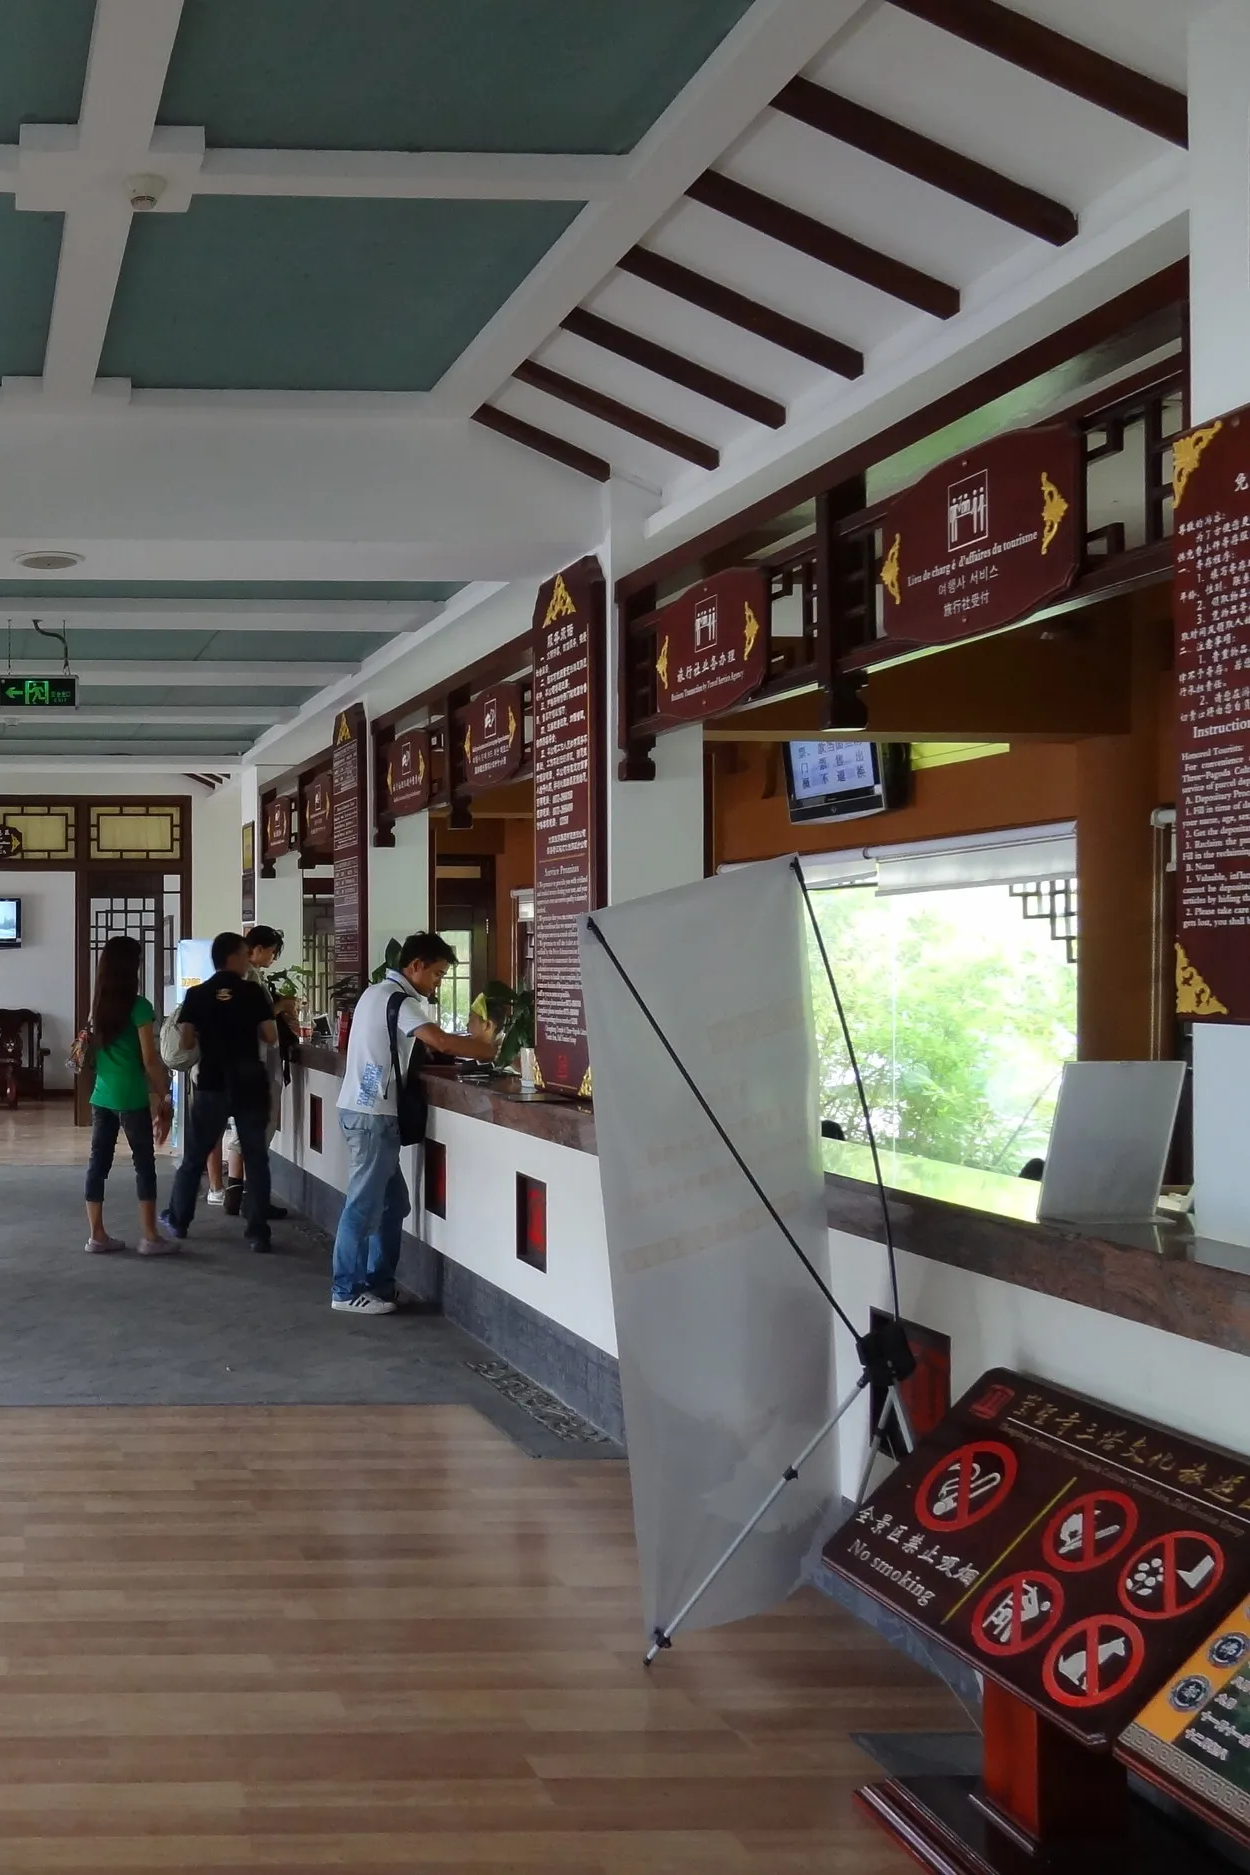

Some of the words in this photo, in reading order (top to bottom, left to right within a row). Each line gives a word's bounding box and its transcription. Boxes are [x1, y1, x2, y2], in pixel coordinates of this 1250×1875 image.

[907, 575, 922, 587] Lieu
[922, 569, 931, 581] de
[992, 542, 1002, 555] du
[1003, 531, 1038, 551] tourisme
[970, 565, 999, 584] 서비스
[1184, 764, 1198, 772] For
[1201, 757, 1244, 769] convenience
[847, 1538, 871, 1561] No
[870, 1557, 936, 1606] smoking
[855, 1505, 980, 1588] 全景区禁止吸烟
